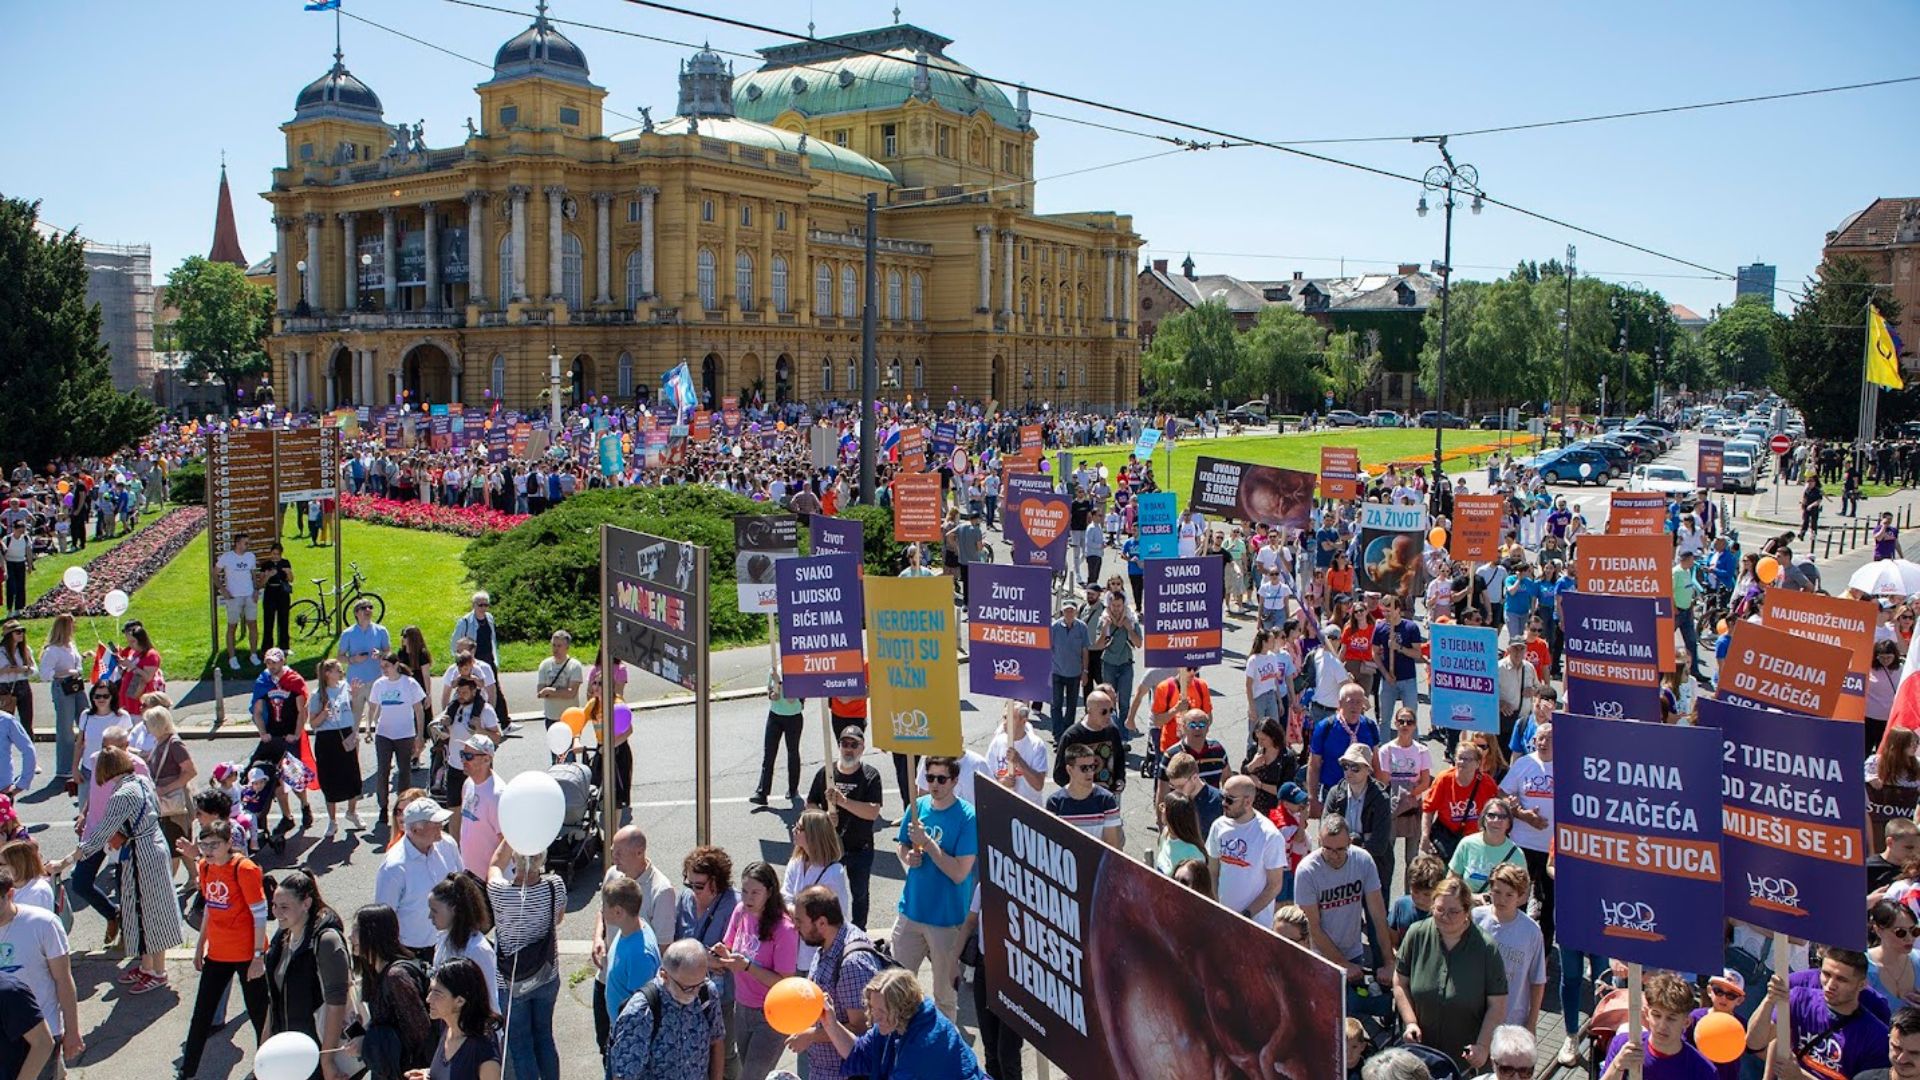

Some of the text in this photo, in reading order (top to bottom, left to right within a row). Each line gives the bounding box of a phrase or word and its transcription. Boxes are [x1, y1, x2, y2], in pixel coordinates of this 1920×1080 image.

[1199, 470, 1240, 487] IZGLEDAM
[1213, 463, 1241, 476] OVAKO
[1205, 482, 1239, 496] S DESET
[1202, 491, 1236, 507] TJEDANA
[1366, 507, 1421, 528] ZA ŽIVOT
[823, 530, 845, 546] ŽIVOT
[795, 565, 833, 582] SVAKO
[1165, 565, 1200, 578] SVAKO
[1588, 557, 1657, 571] 7 TJEDANA
[992, 582, 1025, 601] ŽIVOT
[1159, 582, 1207, 596] LJUDSKO
[1588, 576, 1660, 593] OD ZAČEĆA
[791, 587, 841, 605] LJUDSKO
[979, 605, 1040, 624] ZAPOČINJE
[1159, 599, 1207, 613] BIĆE IMA
[793, 609, 844, 627] BIĆE IMA
[876, 609, 945, 632] NEROĐENI
[1156, 618, 1210, 631] PRAVO NA
[1582, 617, 1634, 634] 4 TJEDNA
[1771, 606, 1866, 633] NAJUGROŽENIJA
[792, 633, 848, 650] PRAVO NA
[982, 626, 1036, 645] ZAČEĆEM
[1167, 634, 1199, 649] ŽIVOT
[877, 632, 939, 661] ŽIVOTI SU
[1441, 638, 1486, 654] 9 TJEDANA
[1568, 638, 1653, 658] OD ZAČEĆA IMA
[803, 654, 837, 672] ŽIVOT
[1441, 656, 1487, 673] OD ZAČEĆA
[1568, 661, 1655, 682] OTISKE PRSTIJU
[1744, 650, 1827, 686] 9 TJEDANA
[887, 661, 927, 689] VAŽNI
[1435, 673, 1453, 687] SISA
[1455, 675, 1483, 690] PALAC
[1734, 673, 1821, 711] OD ZAČEĆA
[1592, 700, 1624, 715] HOD
[890, 709, 929, 730] HOD
[1740, 744, 1844, 783] TJEDANA
[1583, 757, 1684, 791] 52 DANA
[1750, 782, 1841, 820] ZAČEĆA
[1571, 793, 1699, 833] OD ZAČEĆA
[1559, 828, 1717, 874] DIJETE ŠTUCA
[1797, 824, 1827, 854] SE
[1834, 835, 1853, 860] :)
[1011, 817, 1078, 893] OVAKO
[987, 845, 1082, 943] IZGLEDAM
[1747, 872, 1798, 898] HOD
[1601, 899, 1656, 924] HOD
[1604, 916, 1658, 933] ZA ŽIVOT
[1007, 900, 1083, 988] S DESET
[1004, 938, 1088, 1038] TJEDANA
